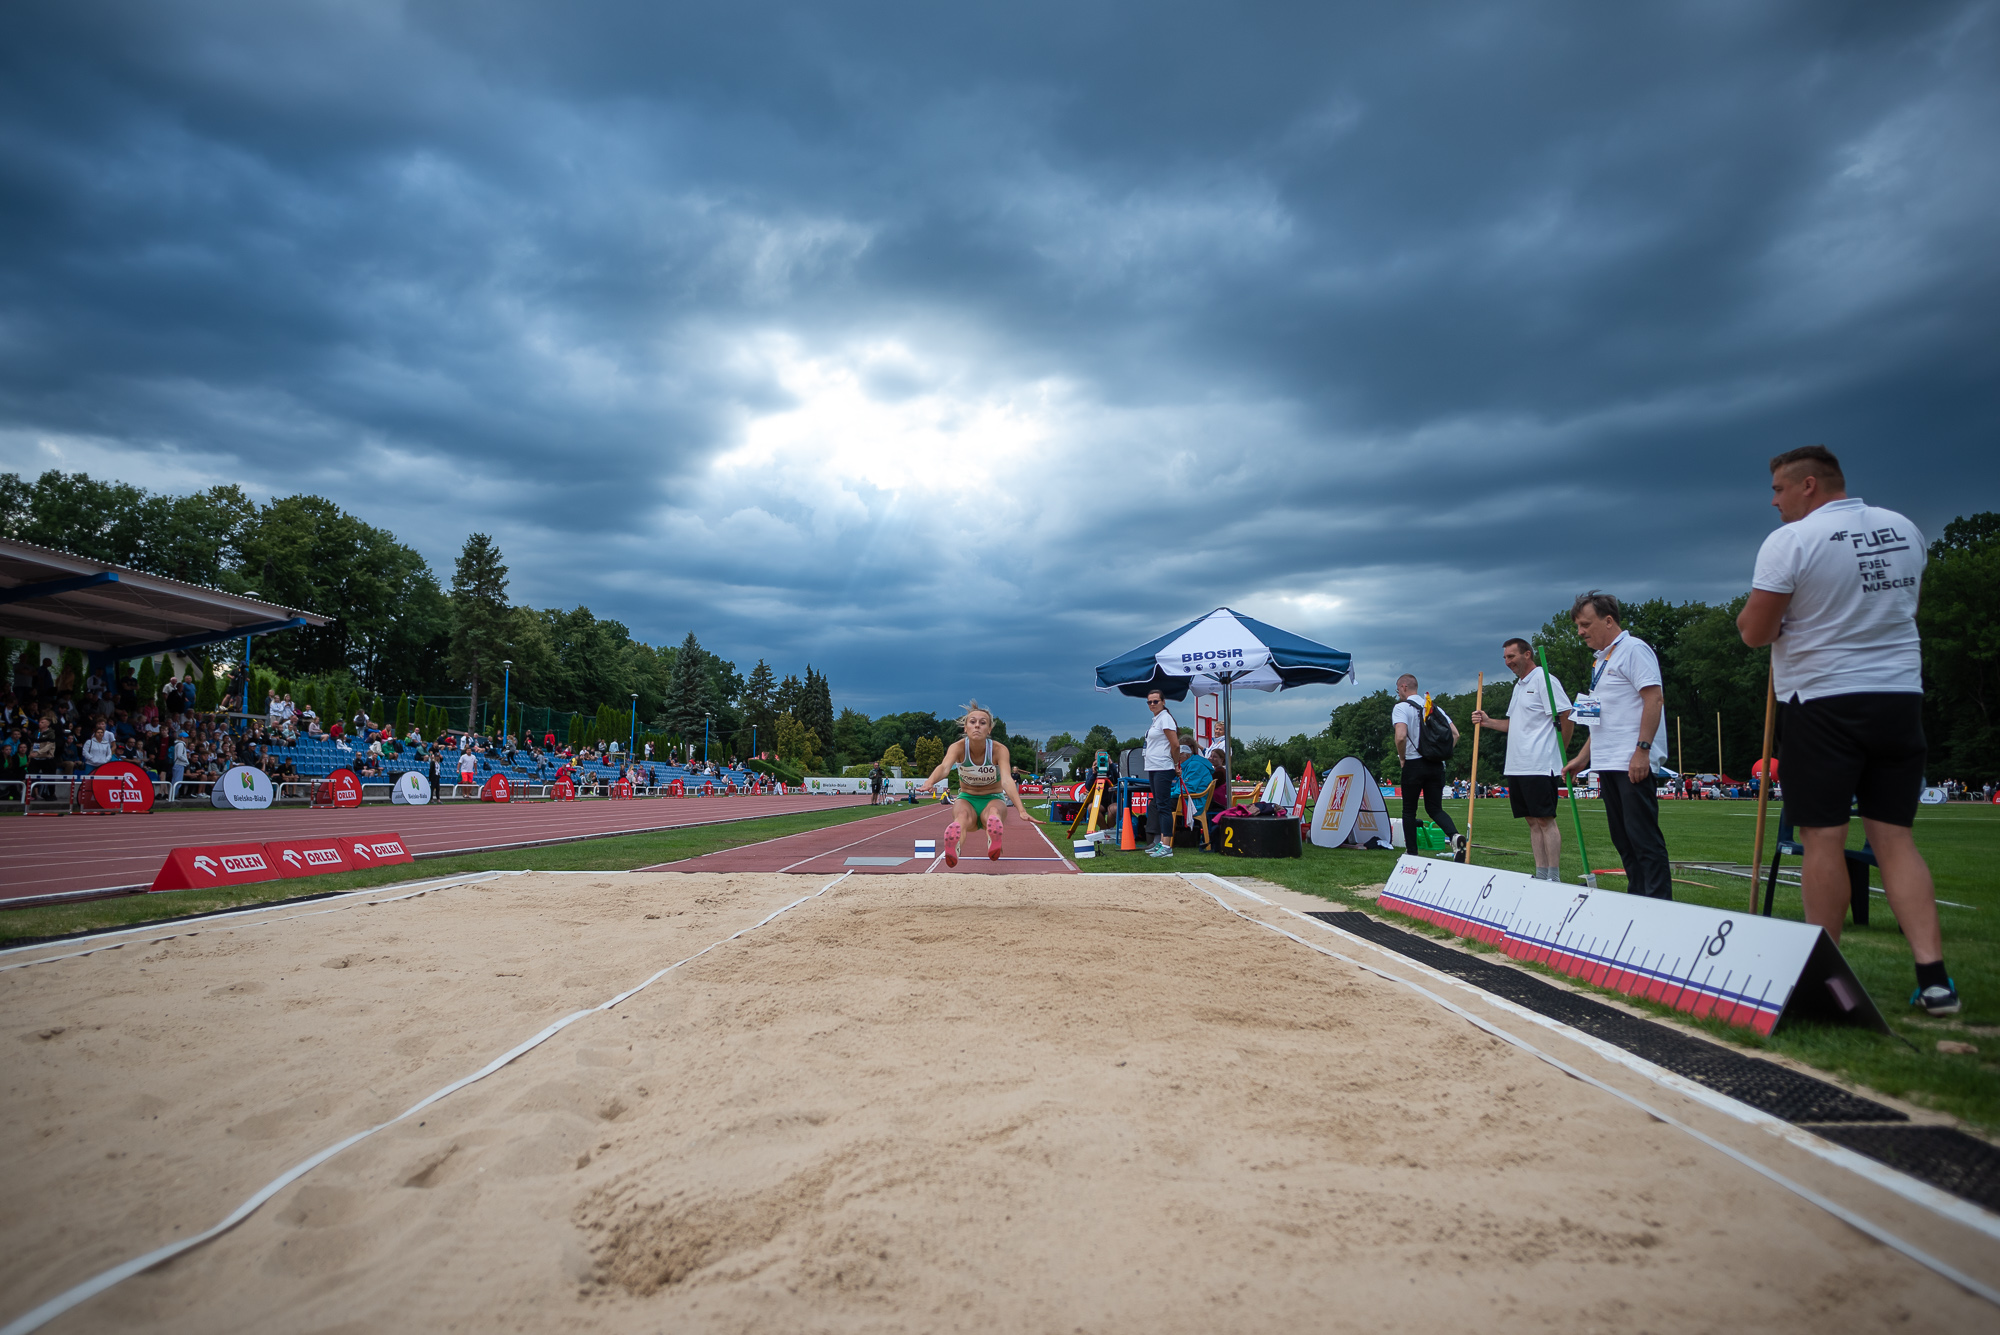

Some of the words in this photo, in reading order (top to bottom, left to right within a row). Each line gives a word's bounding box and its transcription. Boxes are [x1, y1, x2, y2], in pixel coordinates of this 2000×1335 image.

[1850, 527, 1906, 548] FUEL
[1858, 559, 1891, 571] FUEL
[1860, 570, 1886, 581] THE
[977, 766, 994, 774] 406
[338, 791, 355, 800] ORLEN
[1224, 826, 1234, 848] 2
[374, 844, 400, 855] ORLEN
[225, 856, 263, 870] ORLEN
[307, 851, 337, 863] ORLEN
[1418, 863, 1432, 884] 5
[1482, 874, 1496, 899] 6
[1567, 893, 1589, 923] 7
[1707, 919, 1734, 956] 8
